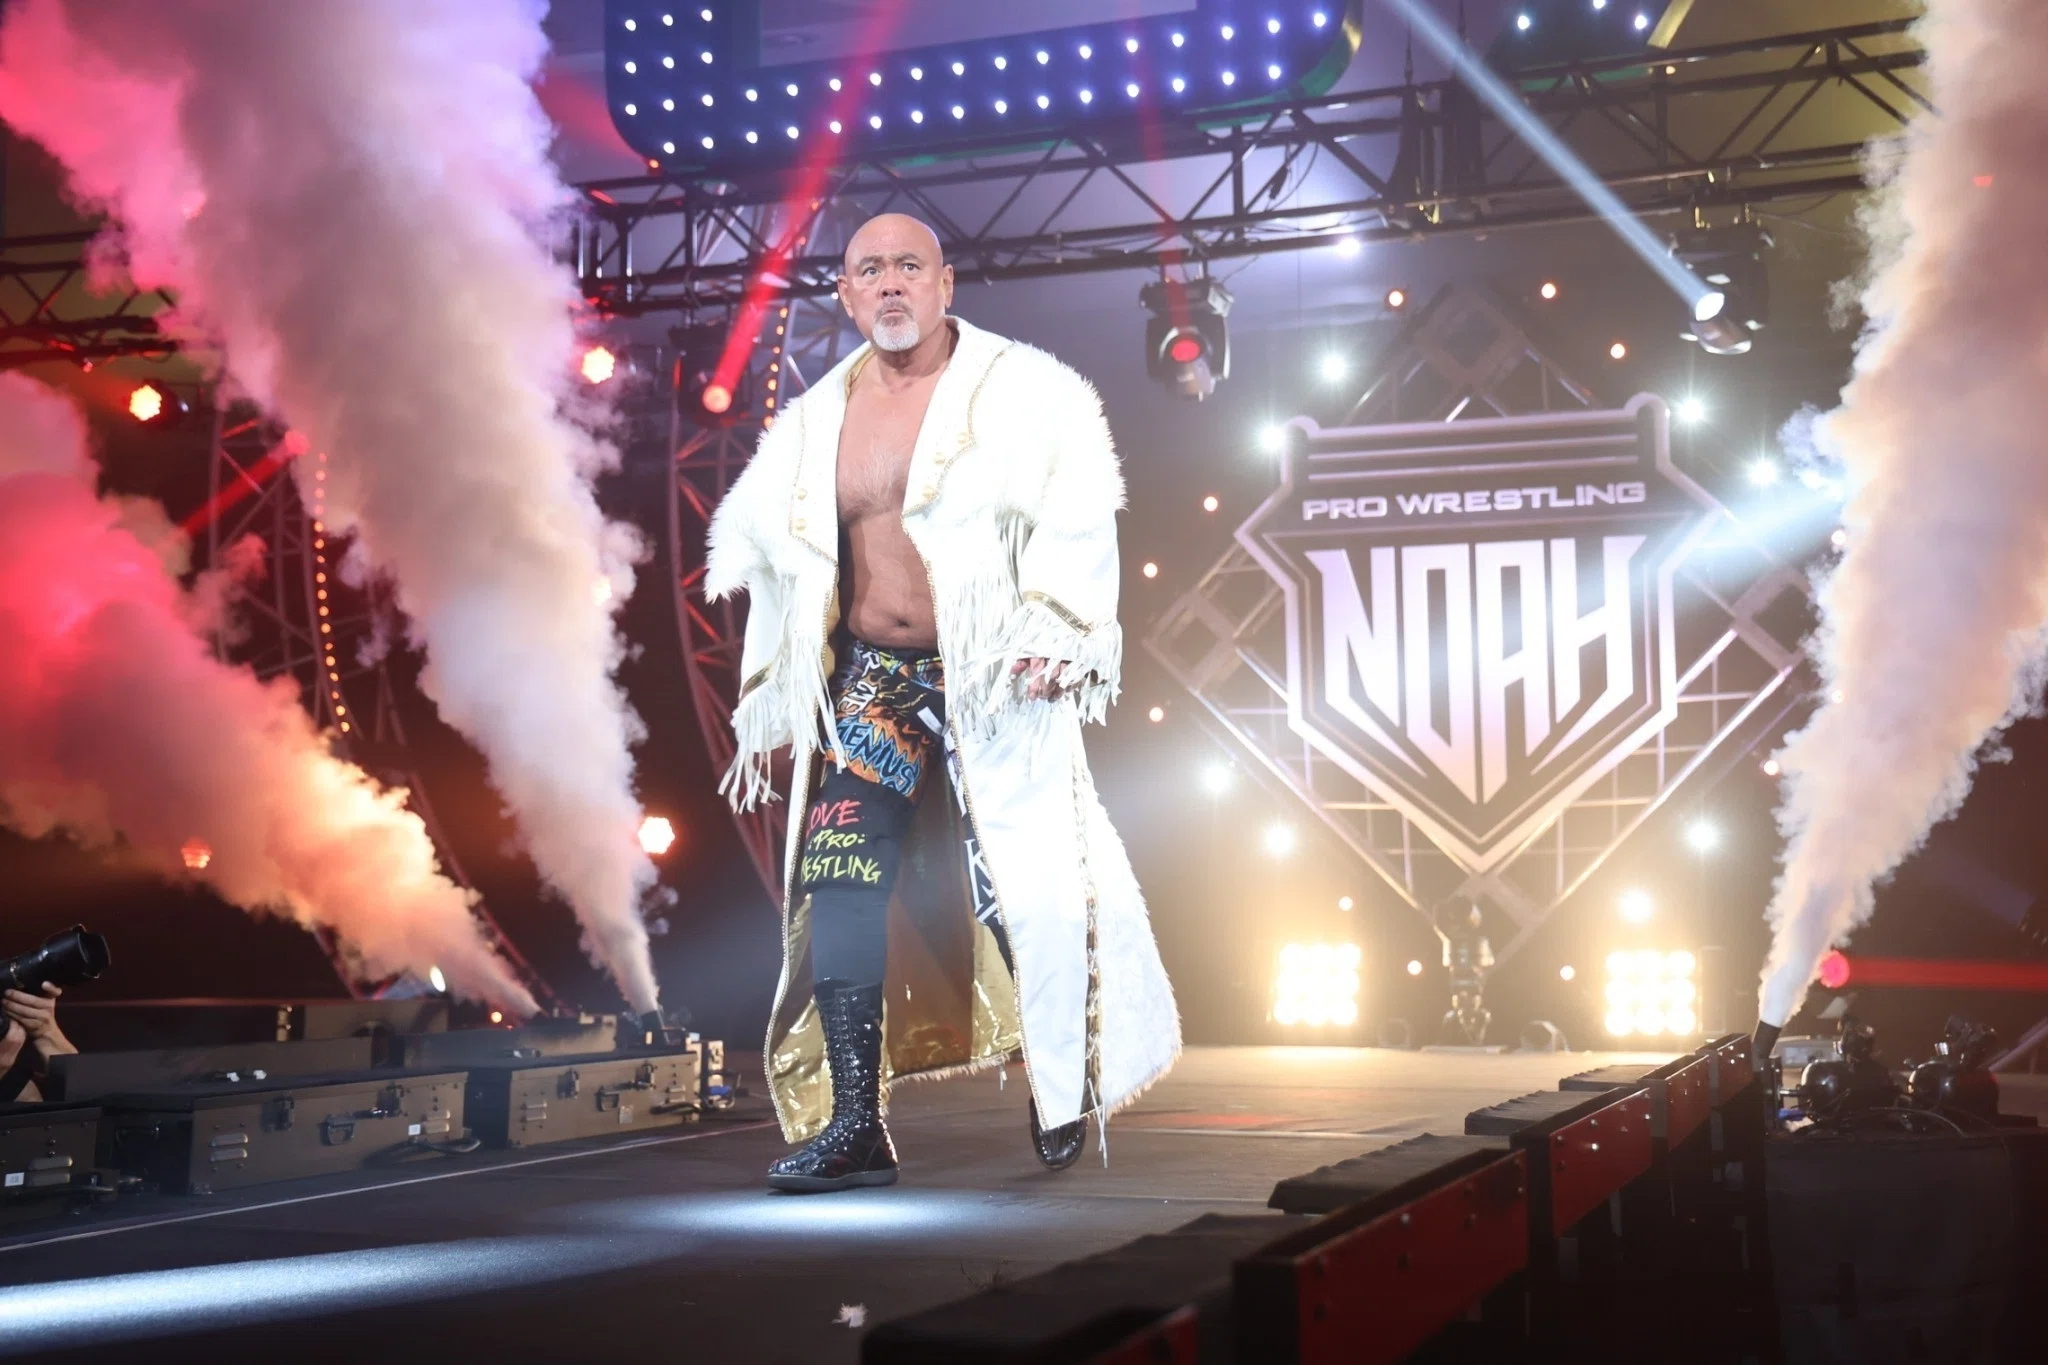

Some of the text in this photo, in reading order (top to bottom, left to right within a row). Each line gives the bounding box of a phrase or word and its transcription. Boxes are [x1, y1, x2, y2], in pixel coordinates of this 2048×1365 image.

[1302, 482, 1647, 521] PRO WRESTLING
[1304, 535, 1648, 804] NOAH
[805, 799, 862, 838] OVE
